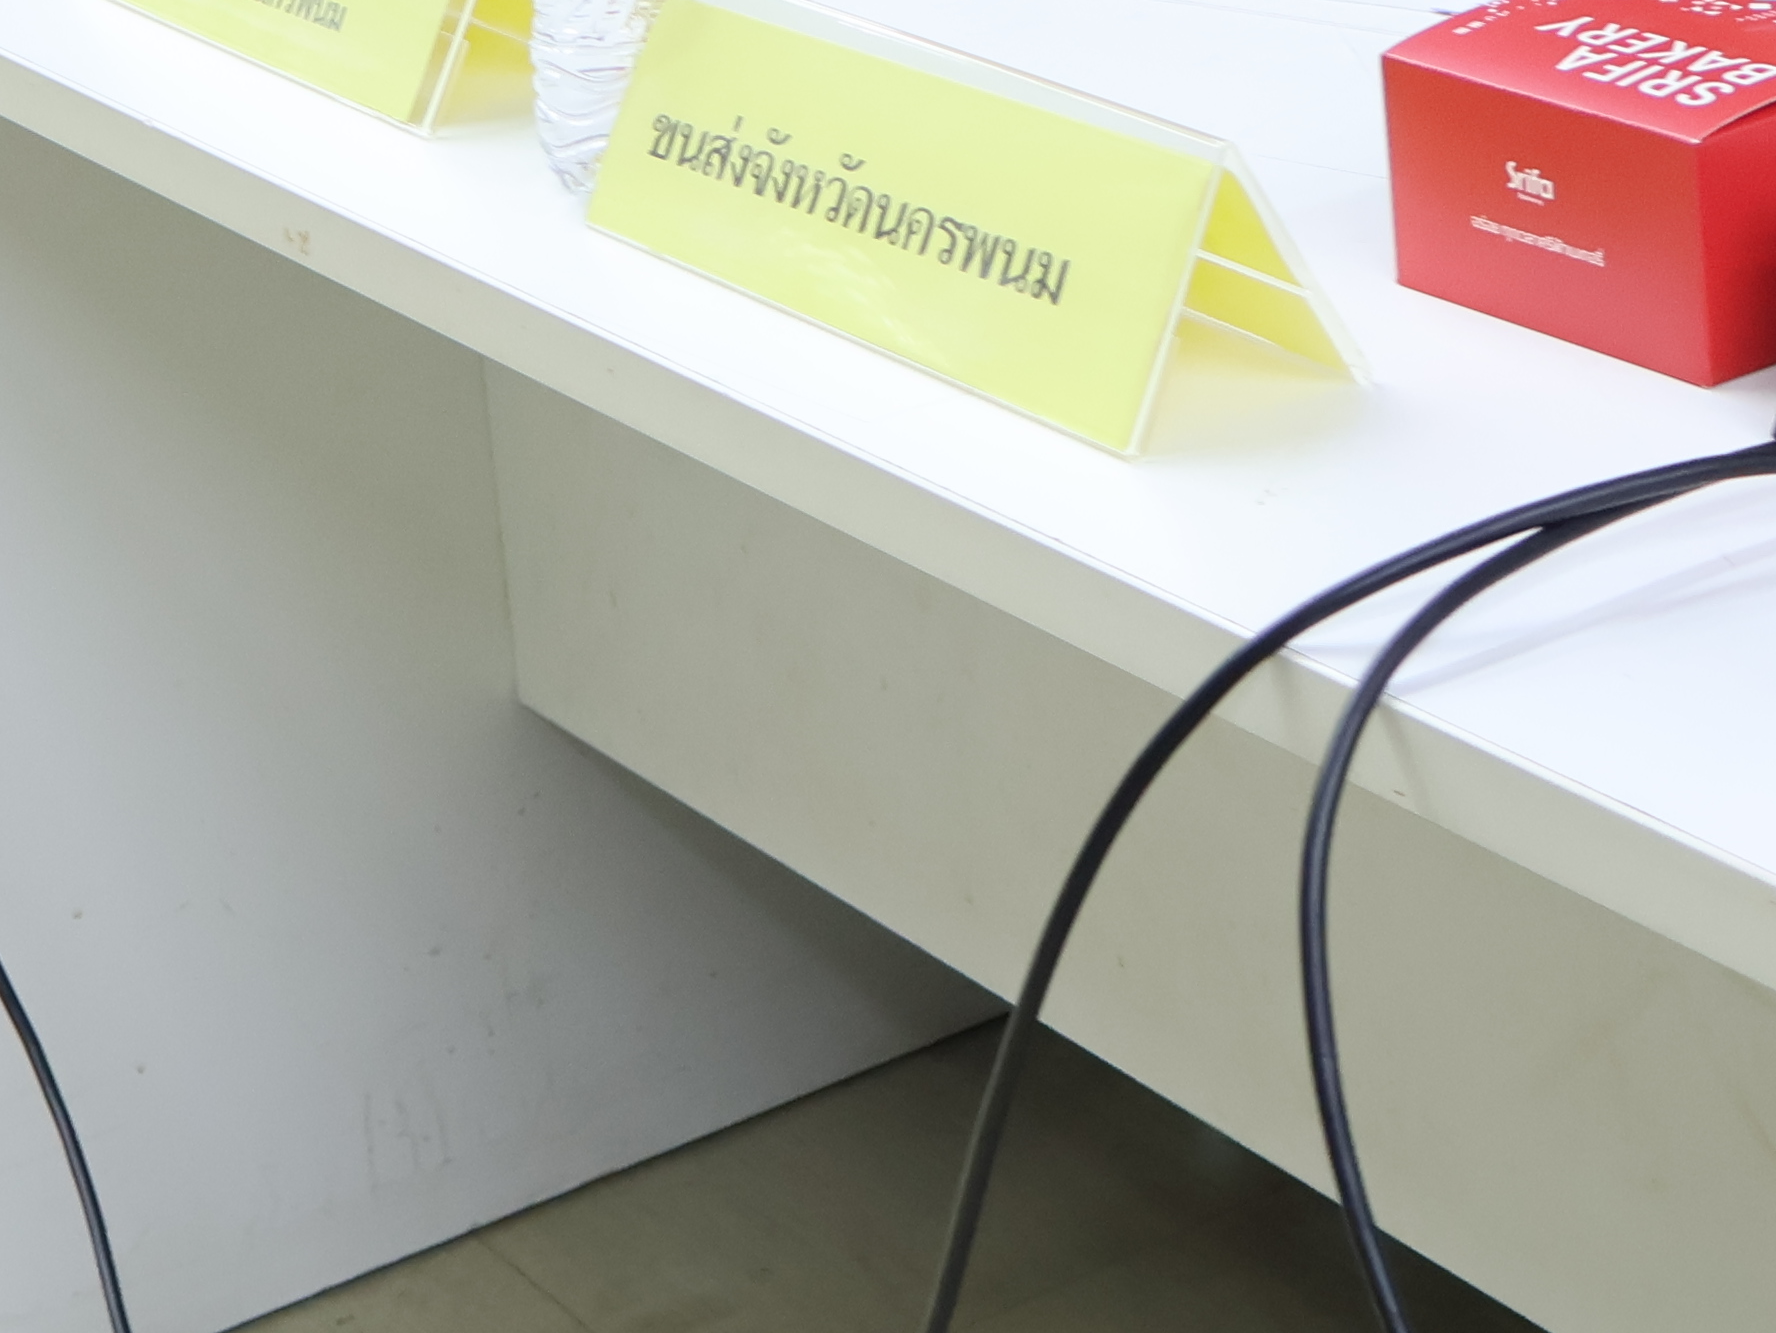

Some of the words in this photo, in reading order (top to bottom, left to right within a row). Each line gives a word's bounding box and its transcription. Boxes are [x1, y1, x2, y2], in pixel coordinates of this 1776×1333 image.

[1554, 50, 1726, 108] SRIFA
[646, 110, 1072, 308] ขนส่งจังหวัดนครพนม
